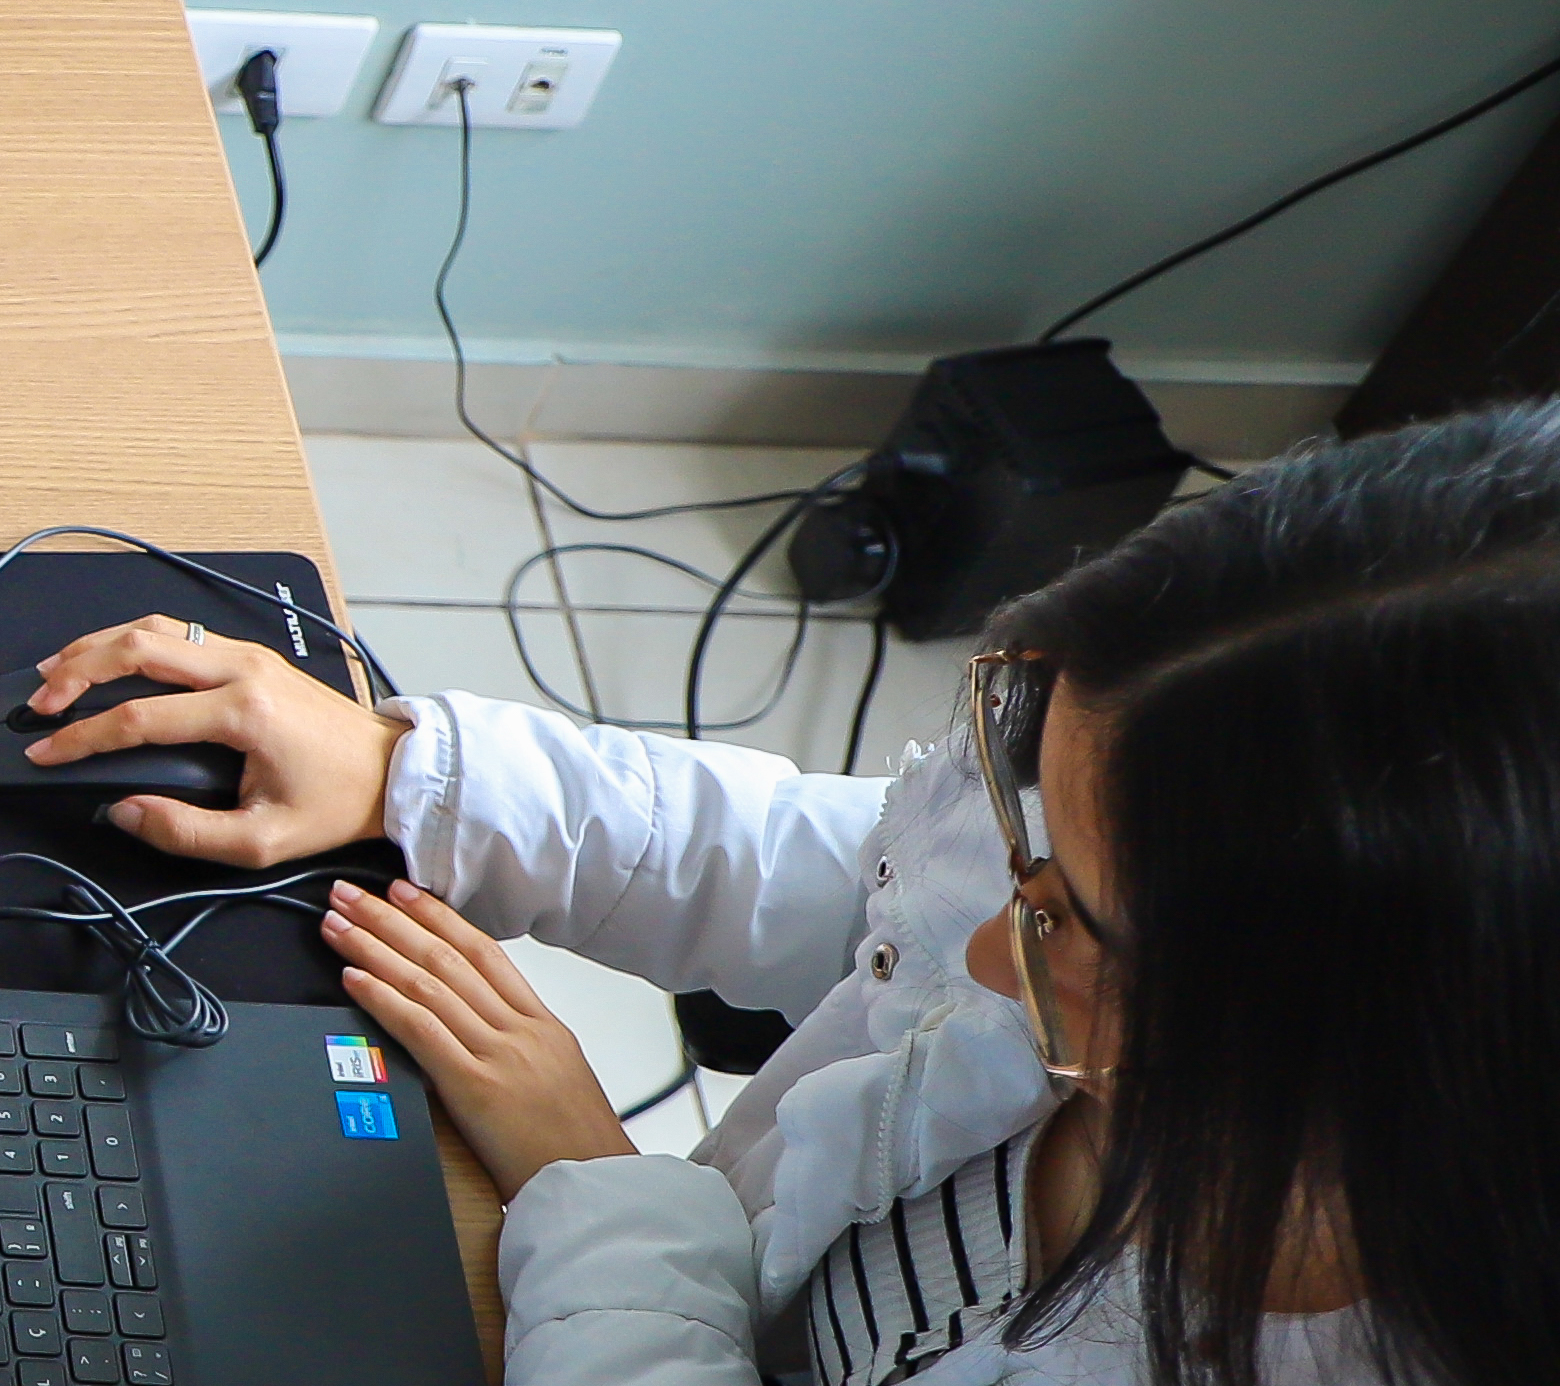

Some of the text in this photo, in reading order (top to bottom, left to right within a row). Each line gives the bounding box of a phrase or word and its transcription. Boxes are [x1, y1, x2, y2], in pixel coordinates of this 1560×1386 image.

[44, 1075, 58, 1083] 3
[50, 1114, 63, 1123] 2
[105, 1137, 119, 1146] 0
[4, 1151, 16, 1159] 4
[28, 1328, 47, 1338] Ç
[36, 1379, 50, 1386] L
